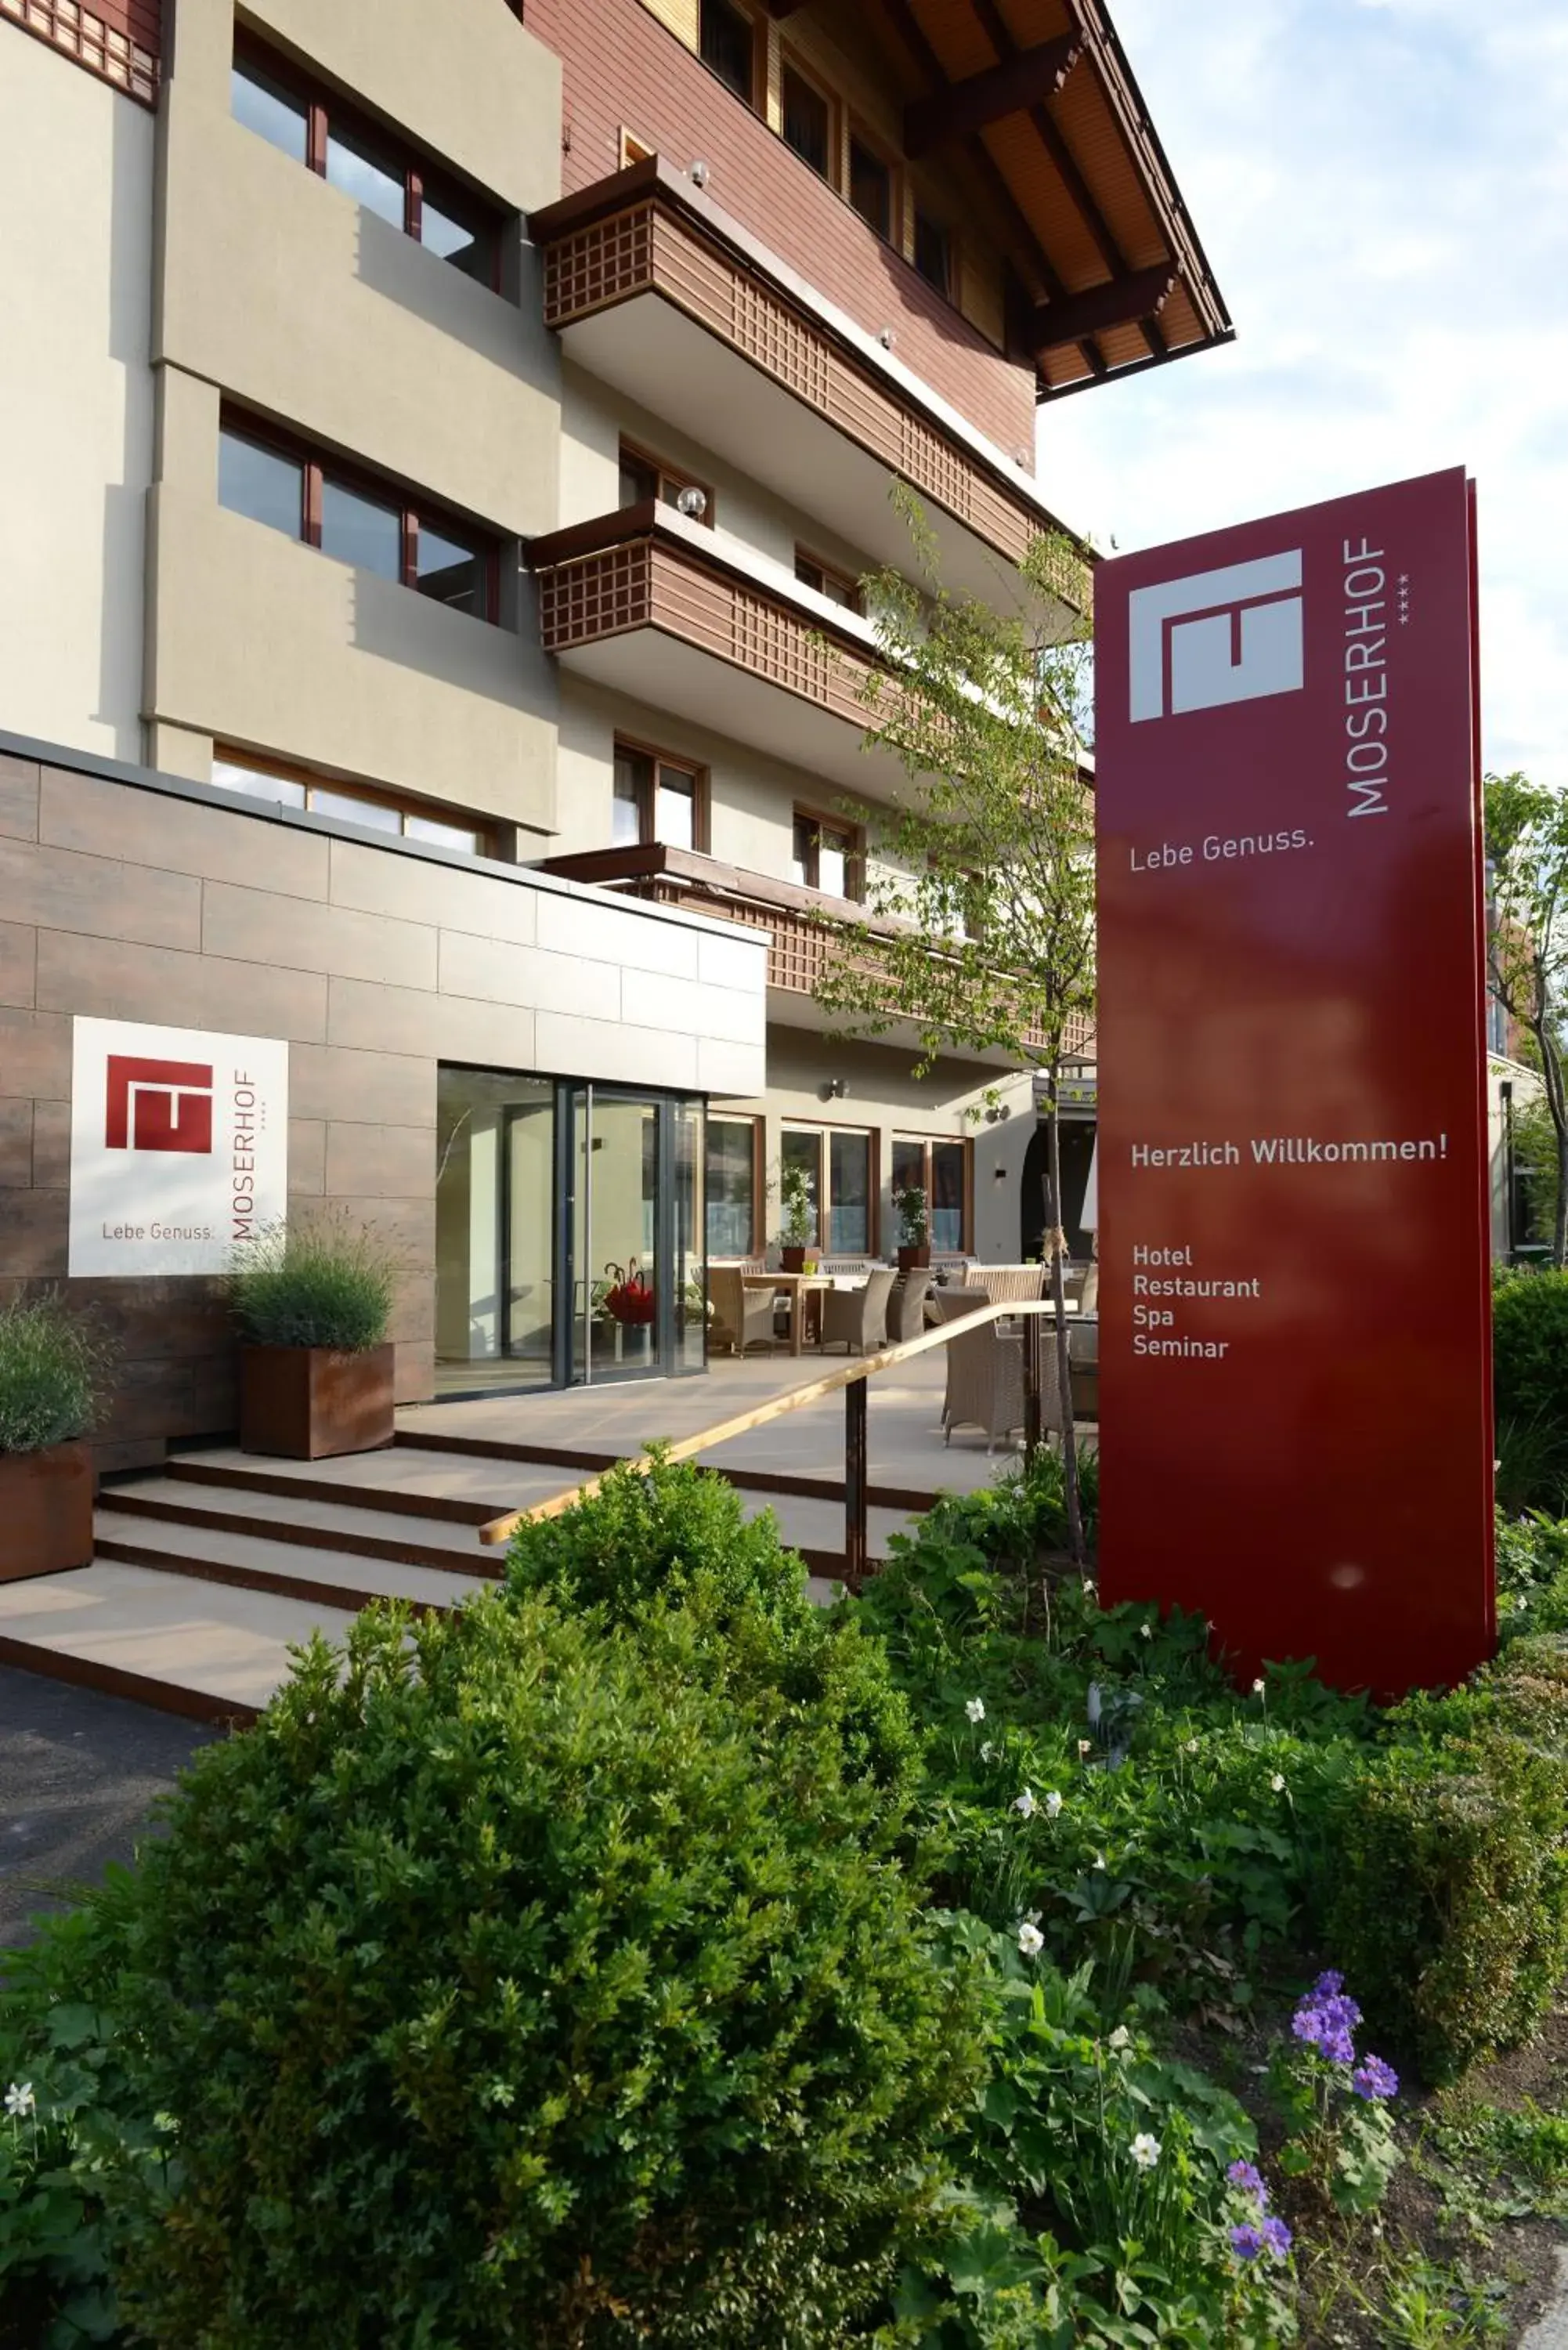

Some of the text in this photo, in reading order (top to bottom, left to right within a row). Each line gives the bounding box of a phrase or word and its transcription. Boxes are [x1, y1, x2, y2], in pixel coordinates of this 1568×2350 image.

[1343, 537, 1389, 817] MOSERHOF
[1129, 828, 1314, 872] Lebe Genuss.
[232, 1069, 256, 1242] MOSERHOF
[1131, 1133, 1447, 1167] Herzlich Willkommen!
[102, 1222, 145, 1240] Lebe
[1133, 1245, 1193, 1267] Hotel
[1133, 1274, 1260, 1299] Restaurant
[1133, 1304, 1174, 1330] Spa
[1133, 1334, 1229, 1359] Seminar
